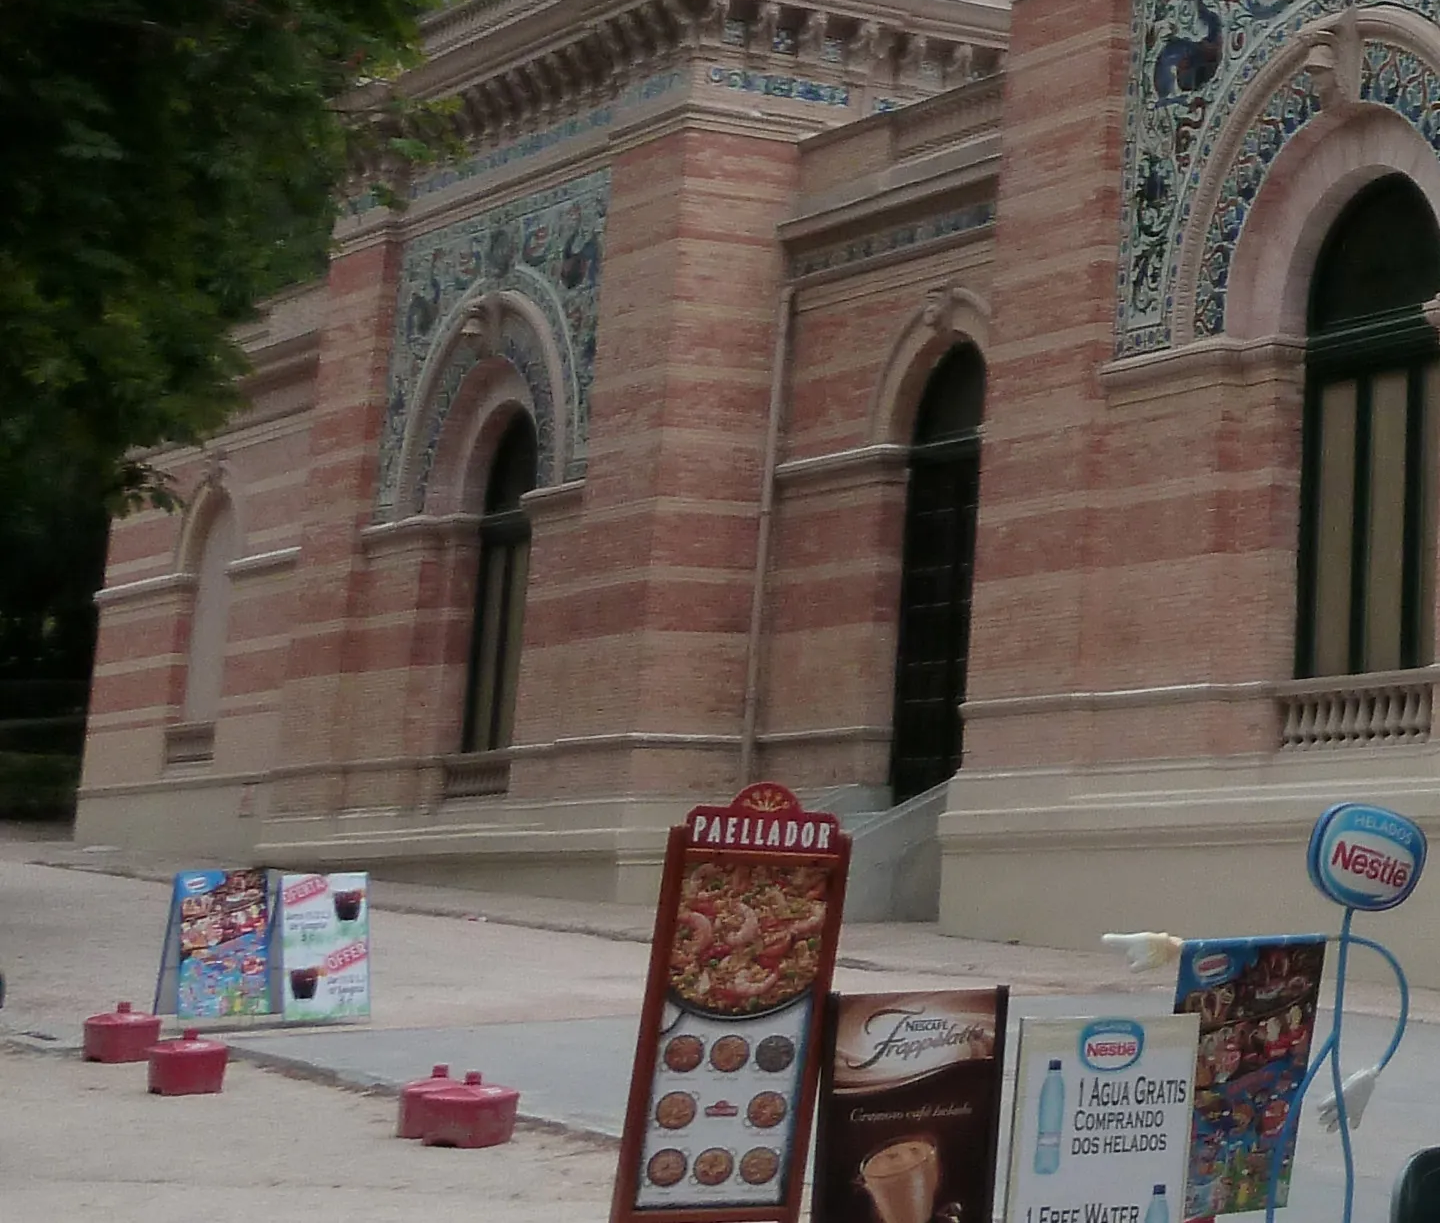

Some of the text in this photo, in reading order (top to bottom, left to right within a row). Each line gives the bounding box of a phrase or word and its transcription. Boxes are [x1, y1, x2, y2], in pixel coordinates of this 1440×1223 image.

[693, 815, 831, 849] PAELLADOR
[1355, 815, 1413, 844] HELADOS
[283, 877, 327, 903] OFERTA
[327, 943, 366, 969] OFFER
[1078, 1076, 1187, 1107] 1 AGUA GRATIS
[1074, 1110, 1164, 1131] COMPRANDO
[1071, 1134, 1167, 1155] DOS HELADOS
